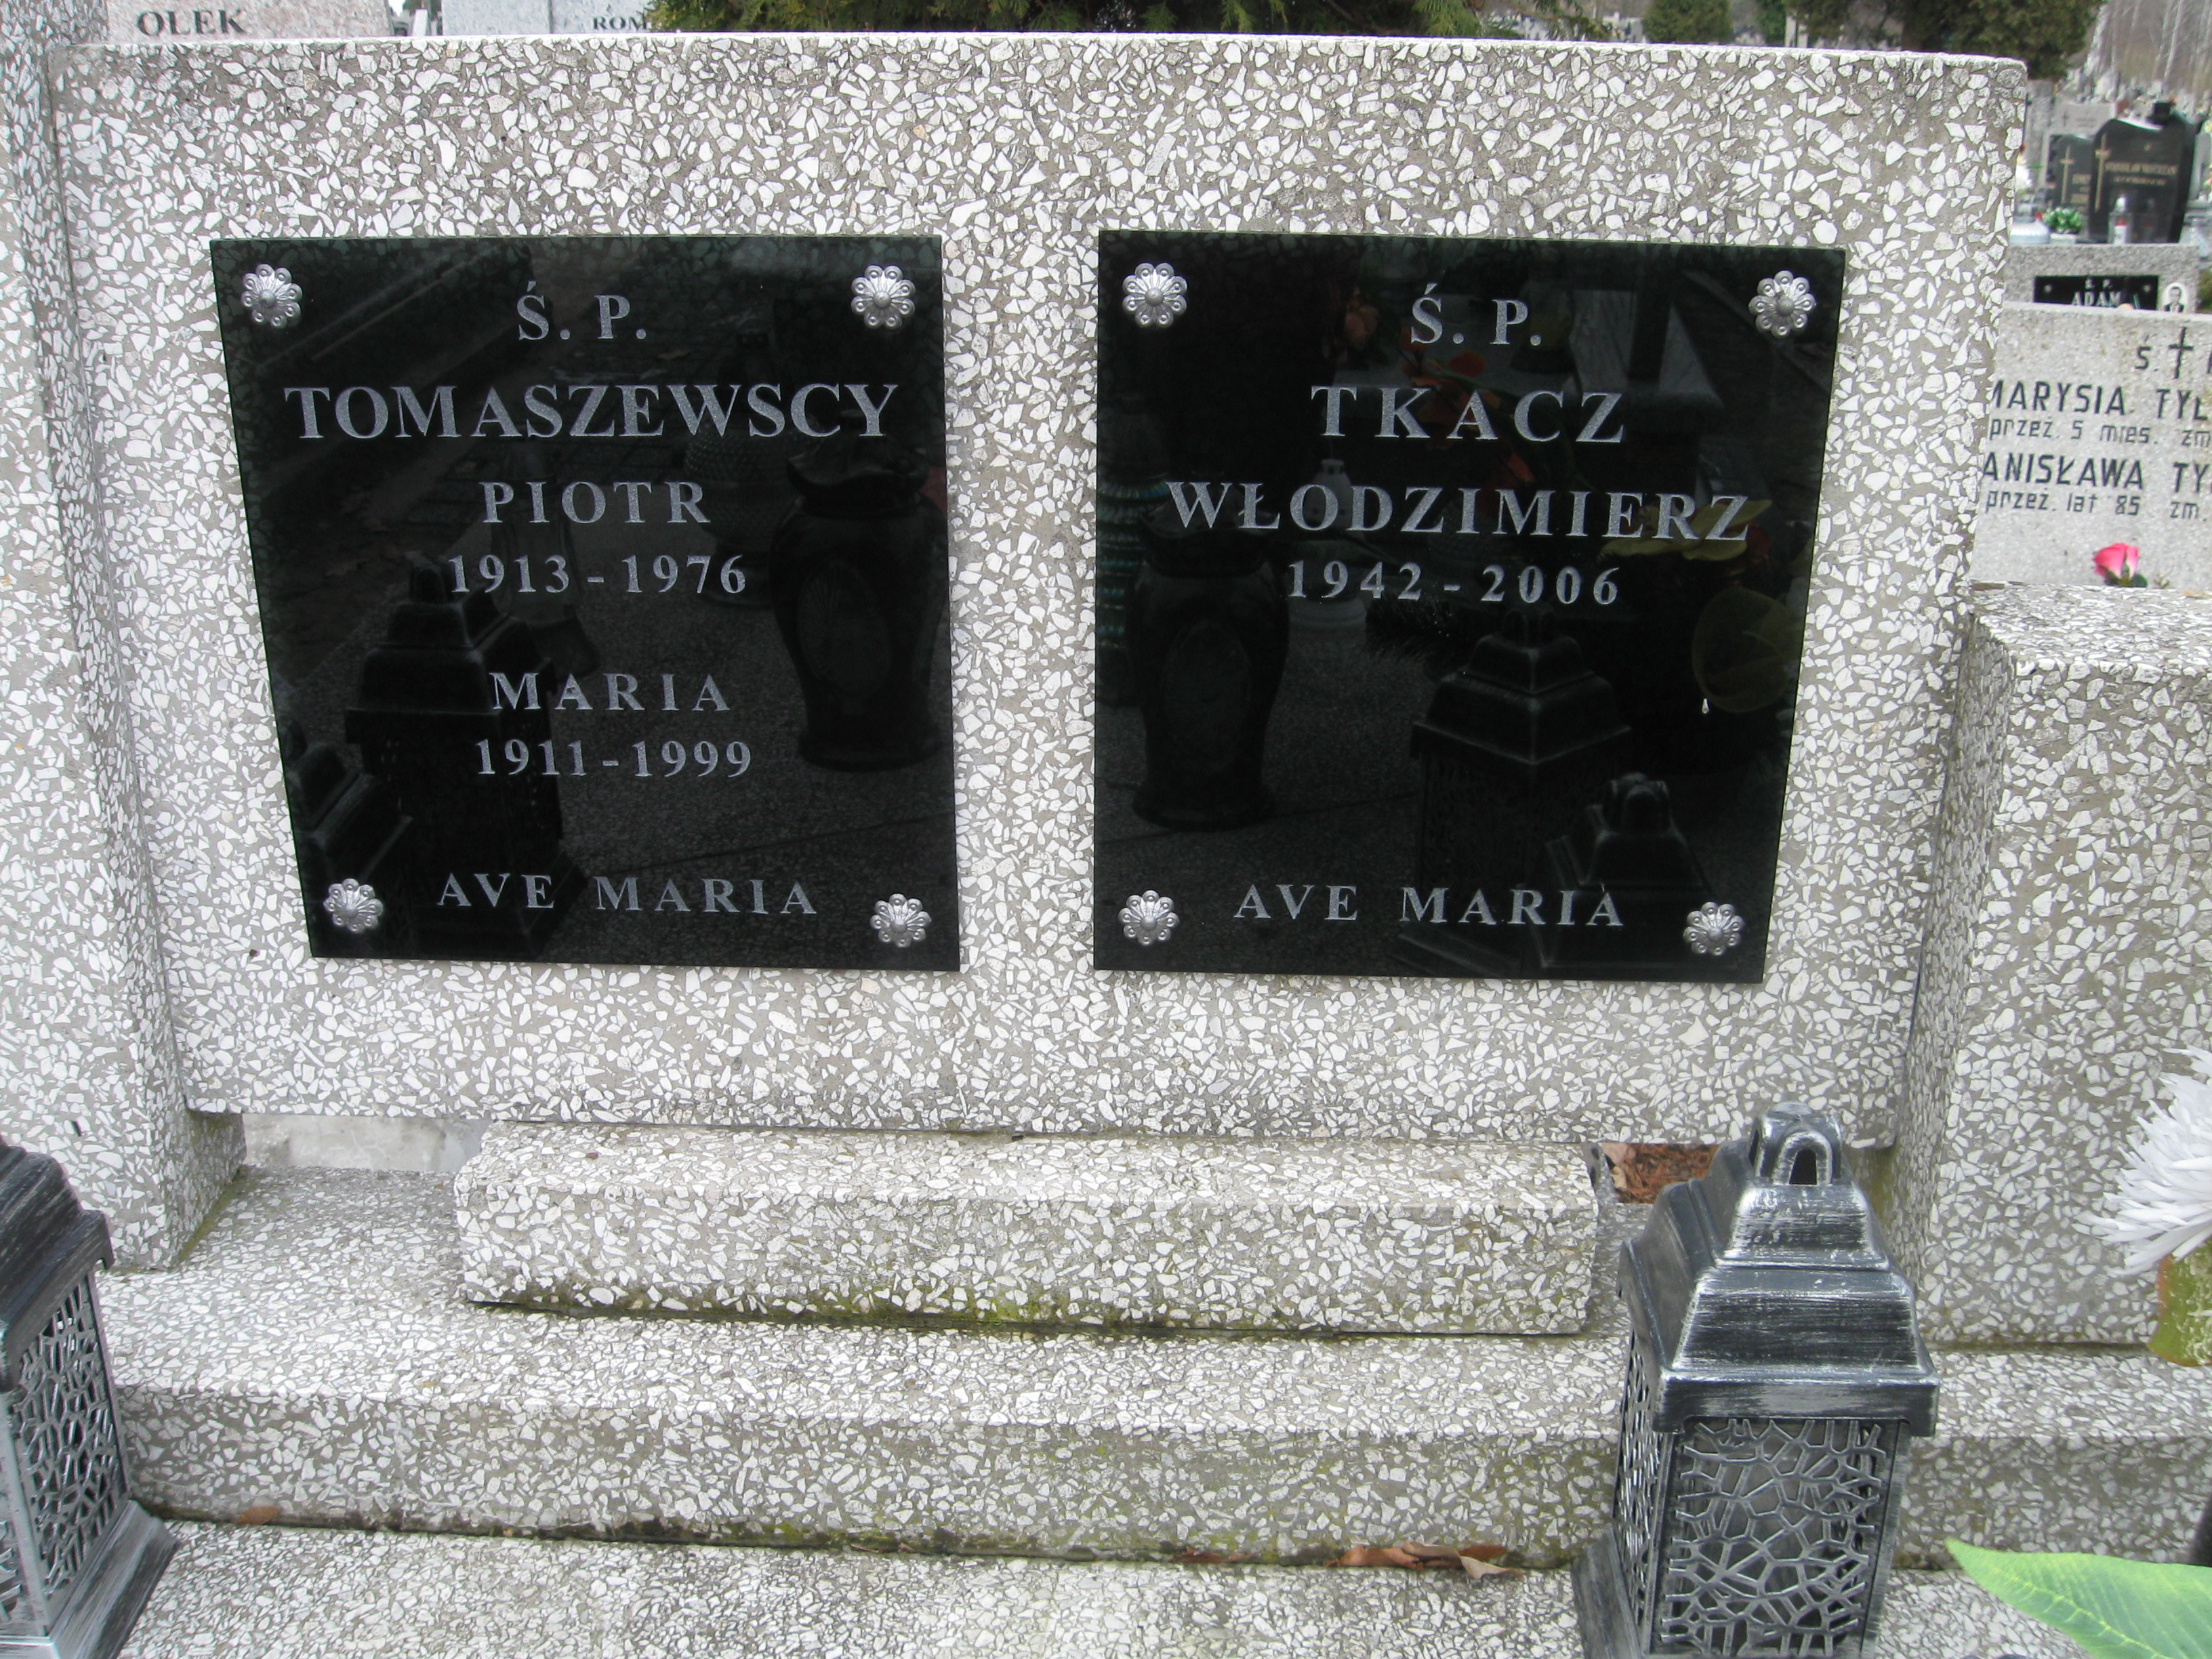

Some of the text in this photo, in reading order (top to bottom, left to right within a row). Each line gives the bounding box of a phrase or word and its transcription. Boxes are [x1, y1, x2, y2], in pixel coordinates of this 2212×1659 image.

[137, 9, 248, 36] OLEK
[596, 294, 647, 340] P.
[1492, 299, 1542, 346] P.
[284, 384, 899, 440] TOMASZEWSCY
[1311, 386, 1623, 444] TKACZ
[2173, 462, 2212, 493] TY
[482, 481, 711, 525] PIOTR
[1165, 481, 1750, 541] WŁODZIMIERZ
[2066, 492, 2098, 514] lat
[2115, 495, 2143, 517] 85
[489, 672, 731, 712] MARIA
[437, 872, 817, 915] AVE MARIA
[1233, 884, 1624, 927] AVE MARIA
